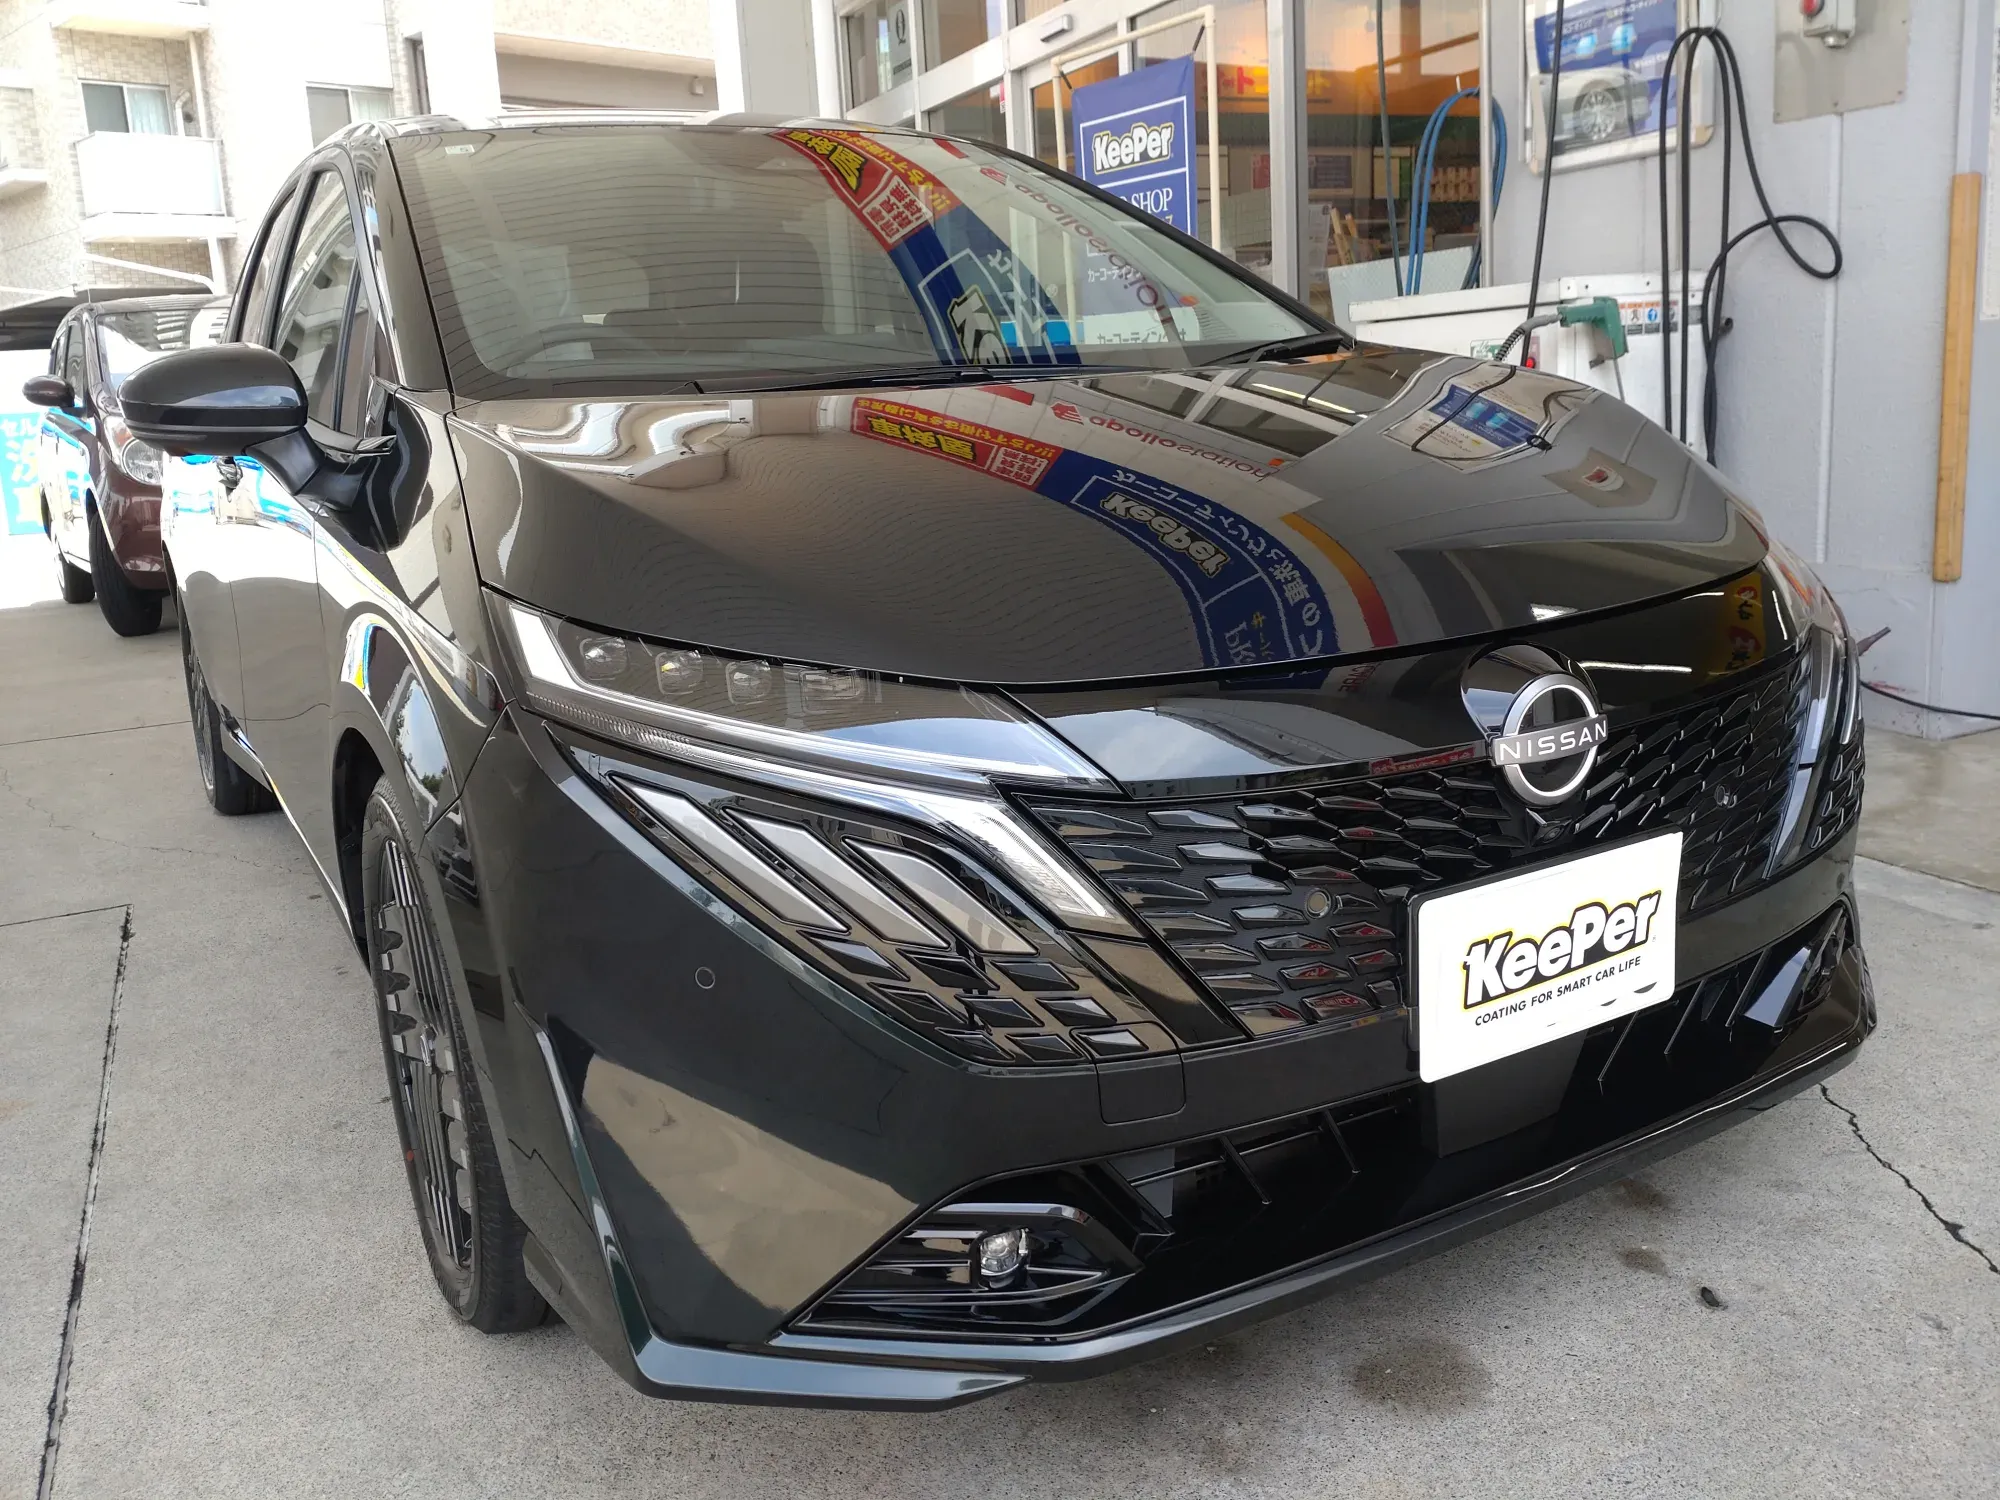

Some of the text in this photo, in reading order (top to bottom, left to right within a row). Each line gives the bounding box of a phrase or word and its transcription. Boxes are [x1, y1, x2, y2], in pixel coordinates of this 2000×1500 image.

[1092, 122, 1175, 175] KeePer
[1131, 187, 1174, 214] SHOP
[1499, 719, 1608, 763] NISSAN
[1462, 889, 1662, 1010] KeePer
[1474, 956, 1642, 1027] COATING FOR SMART CAR LIFE
